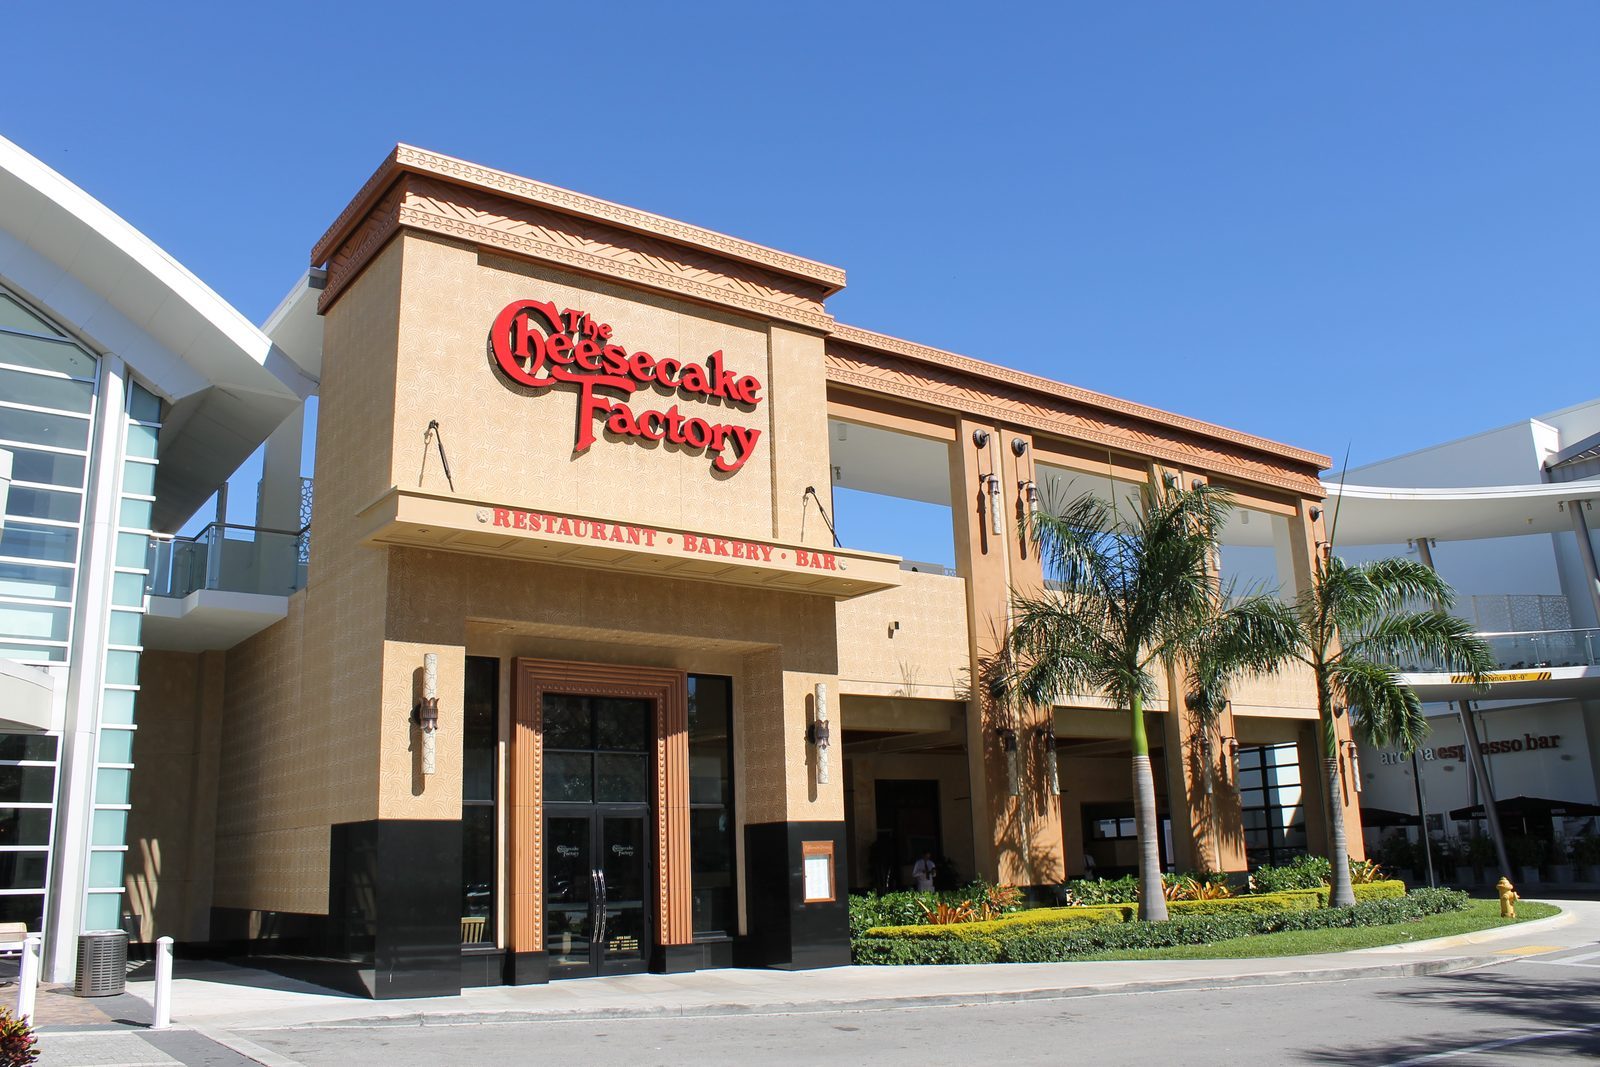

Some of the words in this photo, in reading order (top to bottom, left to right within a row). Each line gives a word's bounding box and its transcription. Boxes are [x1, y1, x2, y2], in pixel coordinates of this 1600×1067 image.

[490, 299, 763, 404] Cheesecake
[563, 308, 612, 340] The
[551, 365, 762, 472] Factory
[493, 508, 656, 547] RESTAURANT
[683, 534, 774, 562] BAKERY
[795, 551, 836, 571] BAR
[1437, 739, 1522, 761] espesso
[1524, 734, 1560, 750] bar
